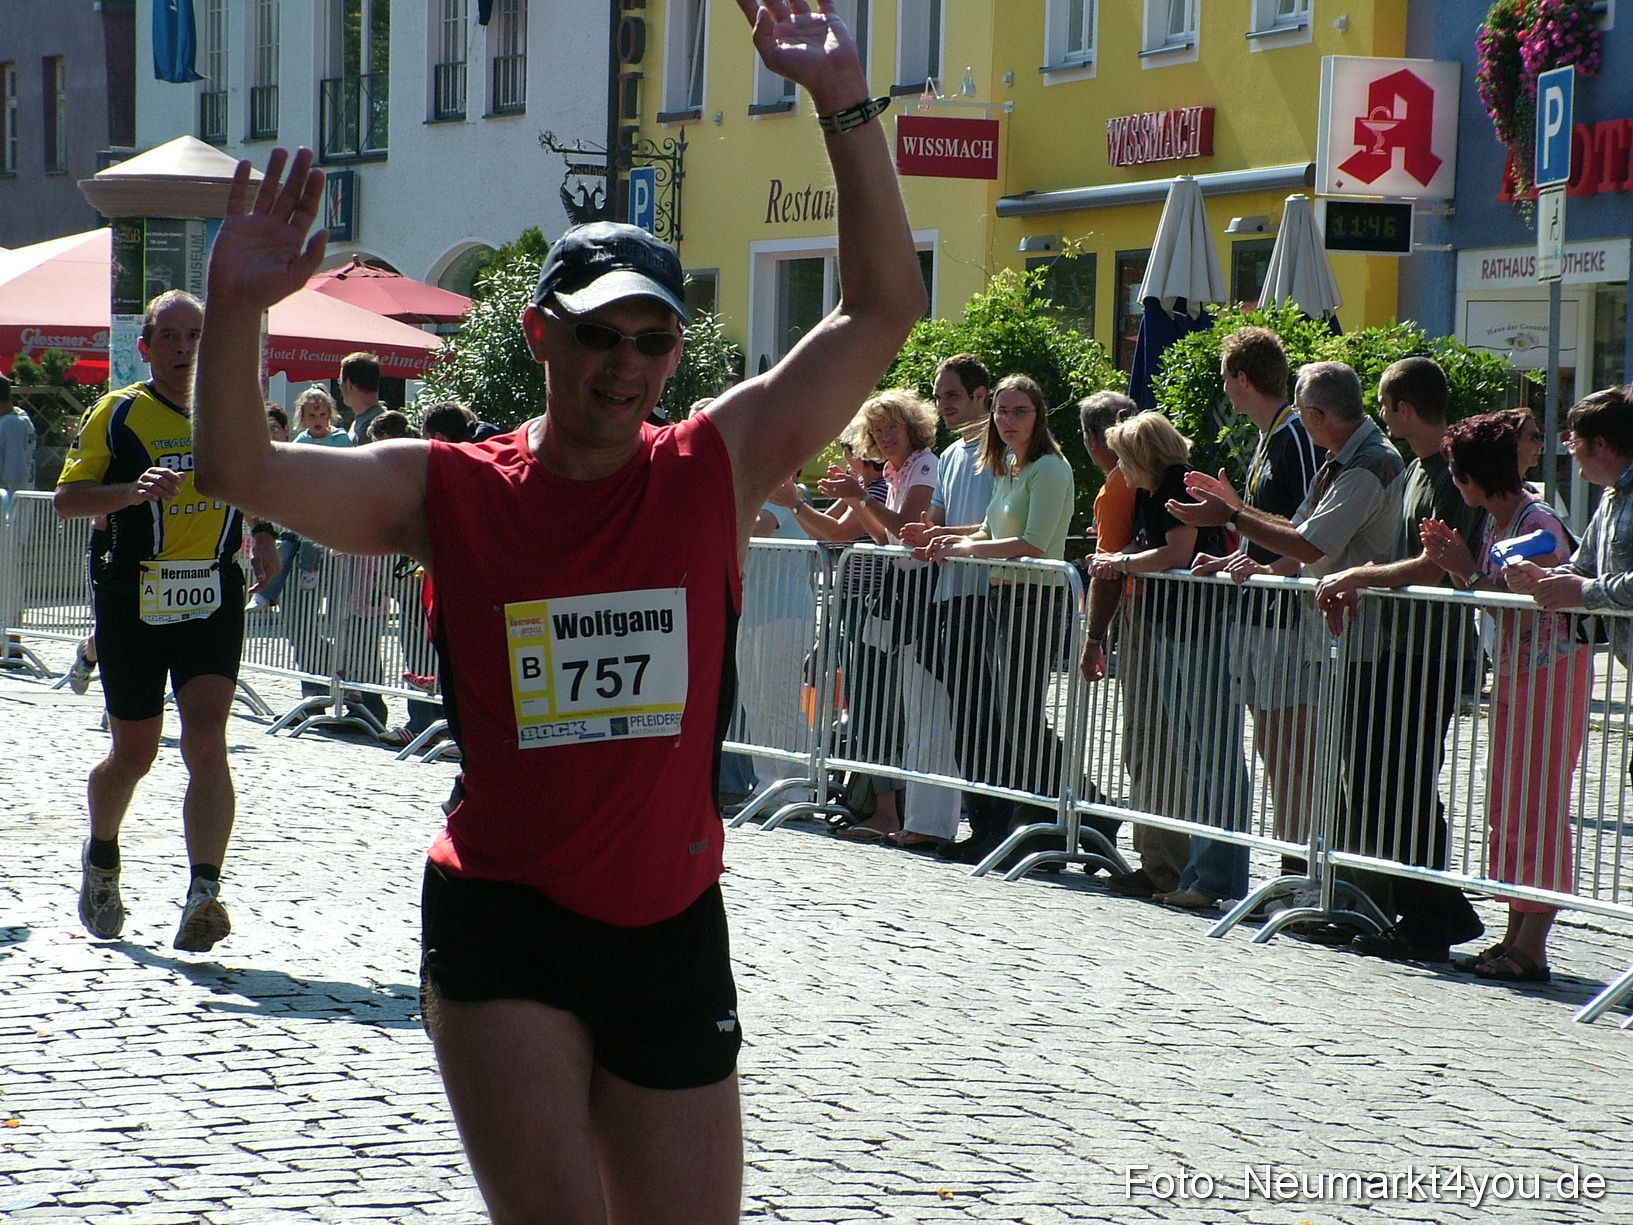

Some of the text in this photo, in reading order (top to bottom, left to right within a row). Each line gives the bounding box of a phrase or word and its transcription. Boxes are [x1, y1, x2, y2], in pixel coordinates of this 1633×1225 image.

[1106, 106, 1203, 166] WISSMACH
[1543, 86, 1564, 170] P
[903, 136, 994, 160] WISSMACH
[634, 178, 649, 226] P
[1481, 255, 1536, 280] RATHAUS
[161, 568, 211, 579] Hermann
[144, 585, 215, 606] A 1000
[552, 608, 674, 640] Wolfgang
[522, 656, 541, 679] B
[562, 654, 651, 702] 757
[520, 721, 587, 741] BOCK
